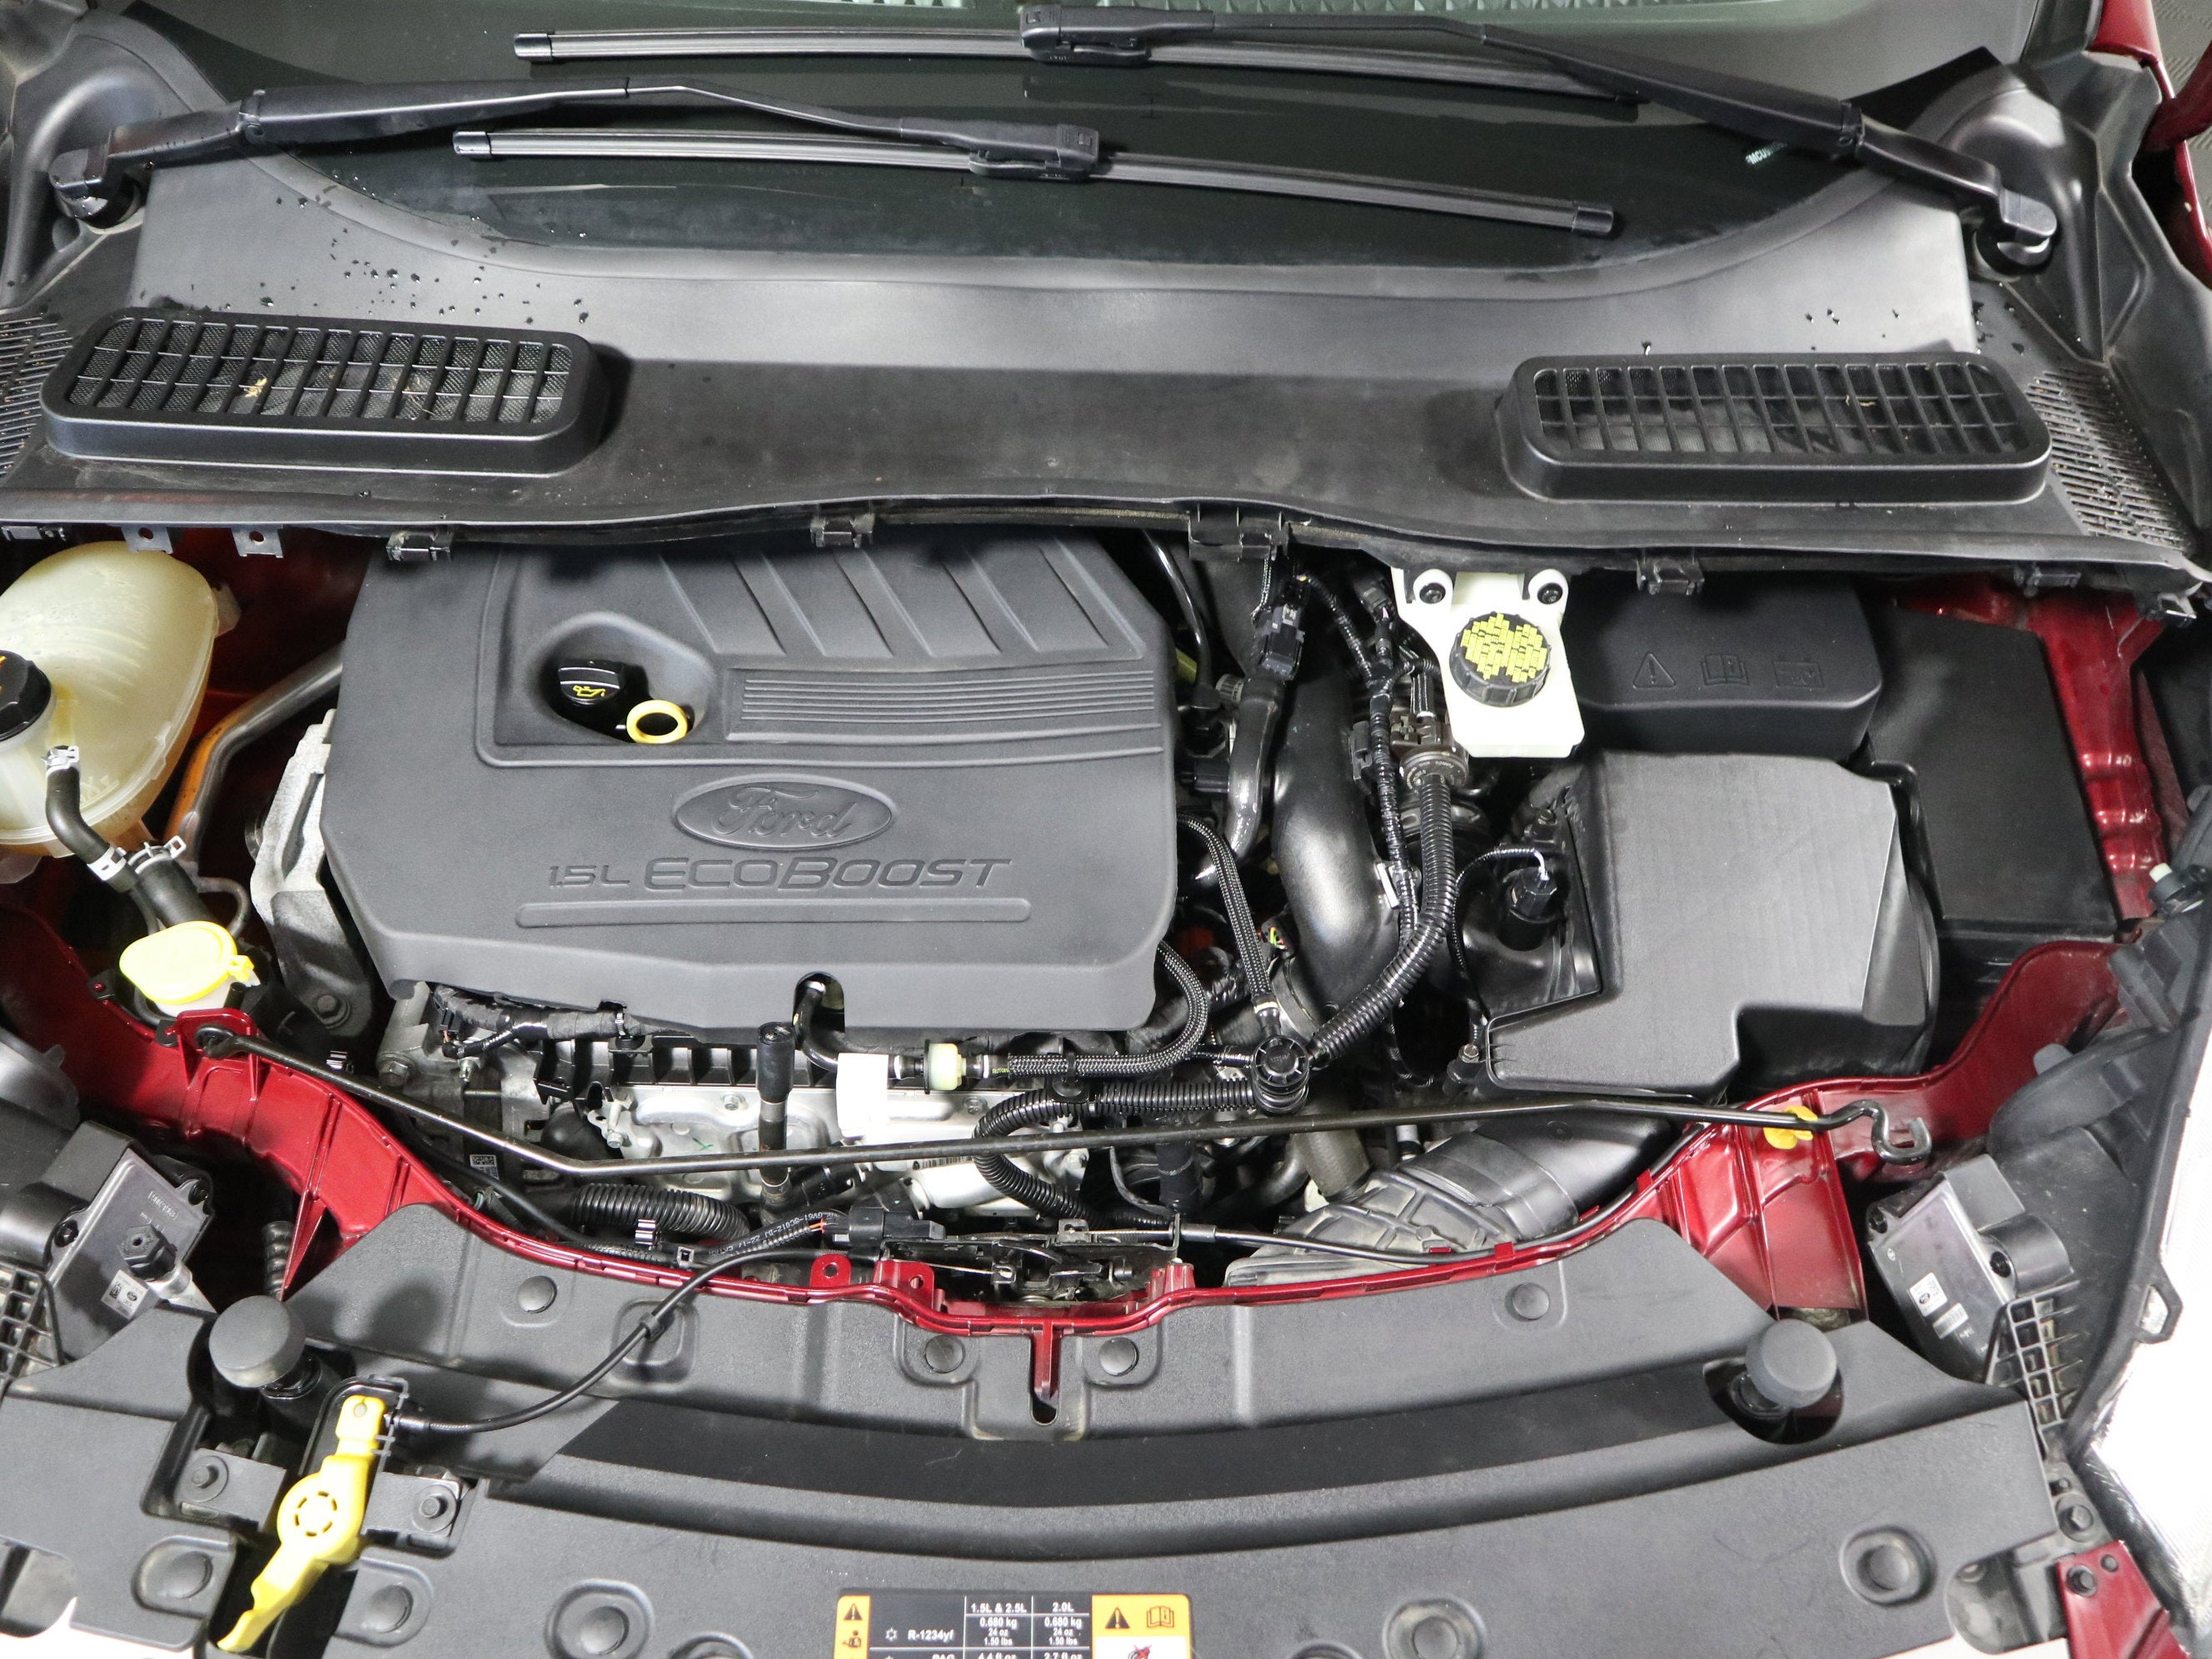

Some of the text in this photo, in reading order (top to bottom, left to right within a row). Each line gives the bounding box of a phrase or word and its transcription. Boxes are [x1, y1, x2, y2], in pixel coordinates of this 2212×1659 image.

[712, 786, 858, 838] Ford
[549, 864, 630, 888] 1.5L
[971, 1602, 1027, 1613] 1.5L & 2.5L
[1052, 1602, 1074, 1612] 2.0L
[979, 1617, 1018, 1630] 0.680 kg
[1044, 1617, 1083, 1630] 0.680 kg
[908, 1629, 954, 1643] R-1234yf
[988, 1627, 998, 1637] 24
[1053, 1627, 1063, 1637] 24
[984, 1637, 1013, 1646] 1.50 lbs
[1049, 1637, 1079, 1646] 1.50 lbs
